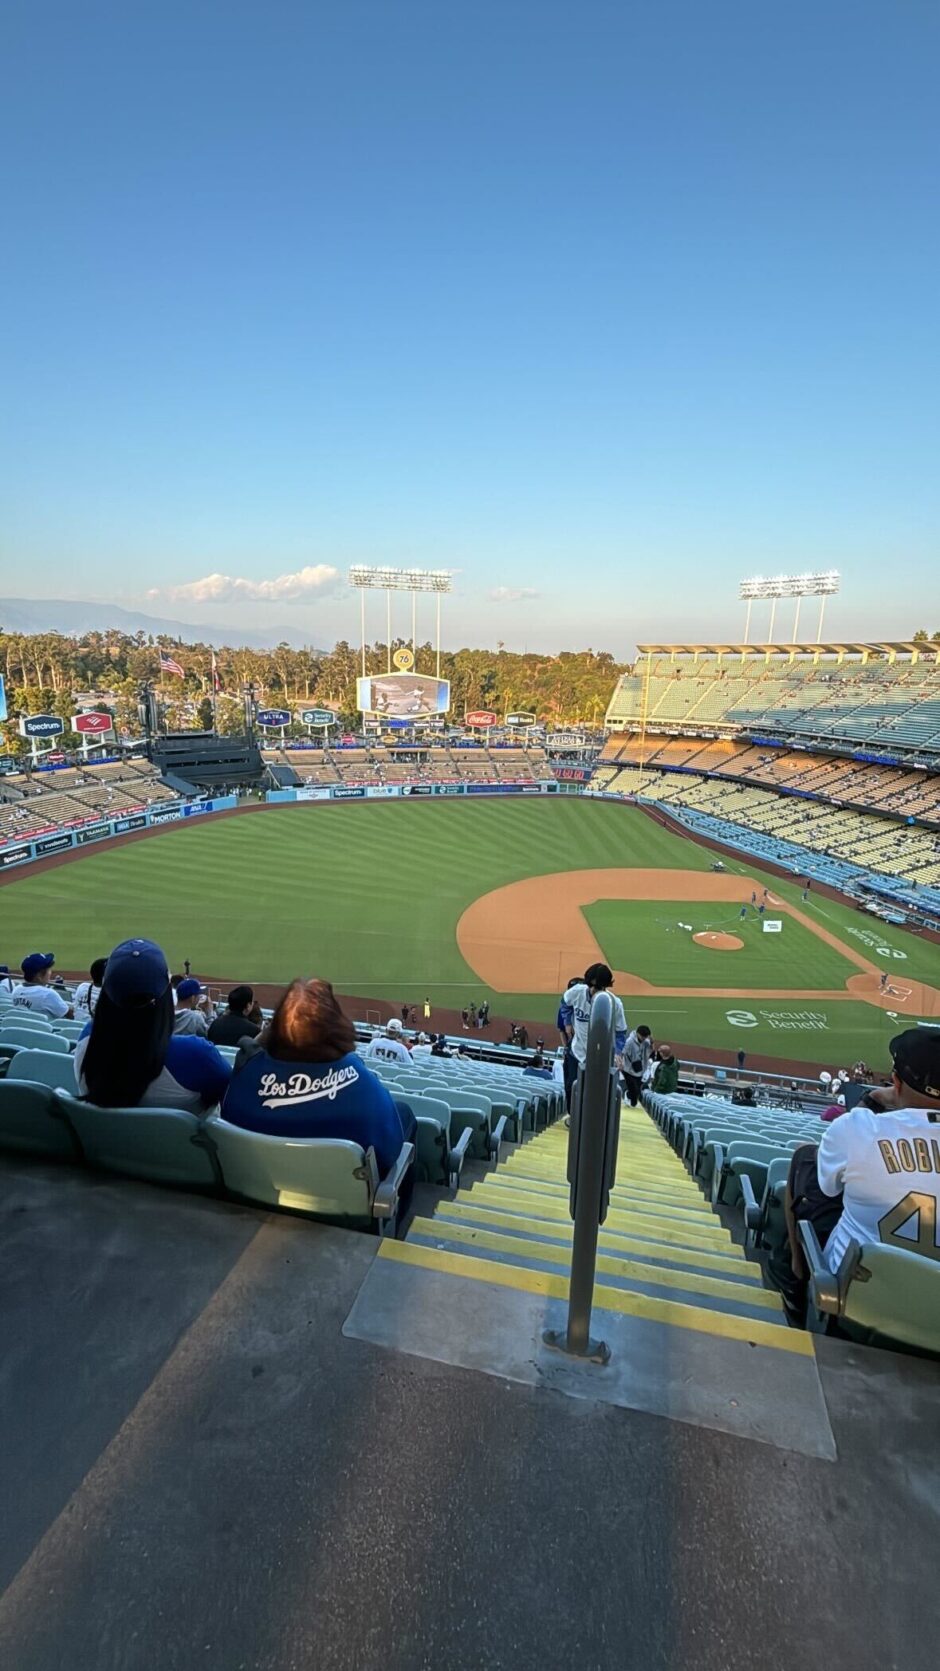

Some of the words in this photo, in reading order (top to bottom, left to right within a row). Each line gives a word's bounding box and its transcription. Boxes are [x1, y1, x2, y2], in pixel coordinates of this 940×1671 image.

[400, 655, 409, 663] 76
[28, 722, 61, 732] Spectrum
[335, 789, 362, 797] Spectrum
[154, 812, 181, 825] MORTON
[759, 1010, 828, 1022] Security
[767, 1019, 831, 1030] Benefit
[258, 1073, 287, 1096] Los
[288, 1065, 359, 1100] Dodgers
[878, 1190, 940, 1260] 4
